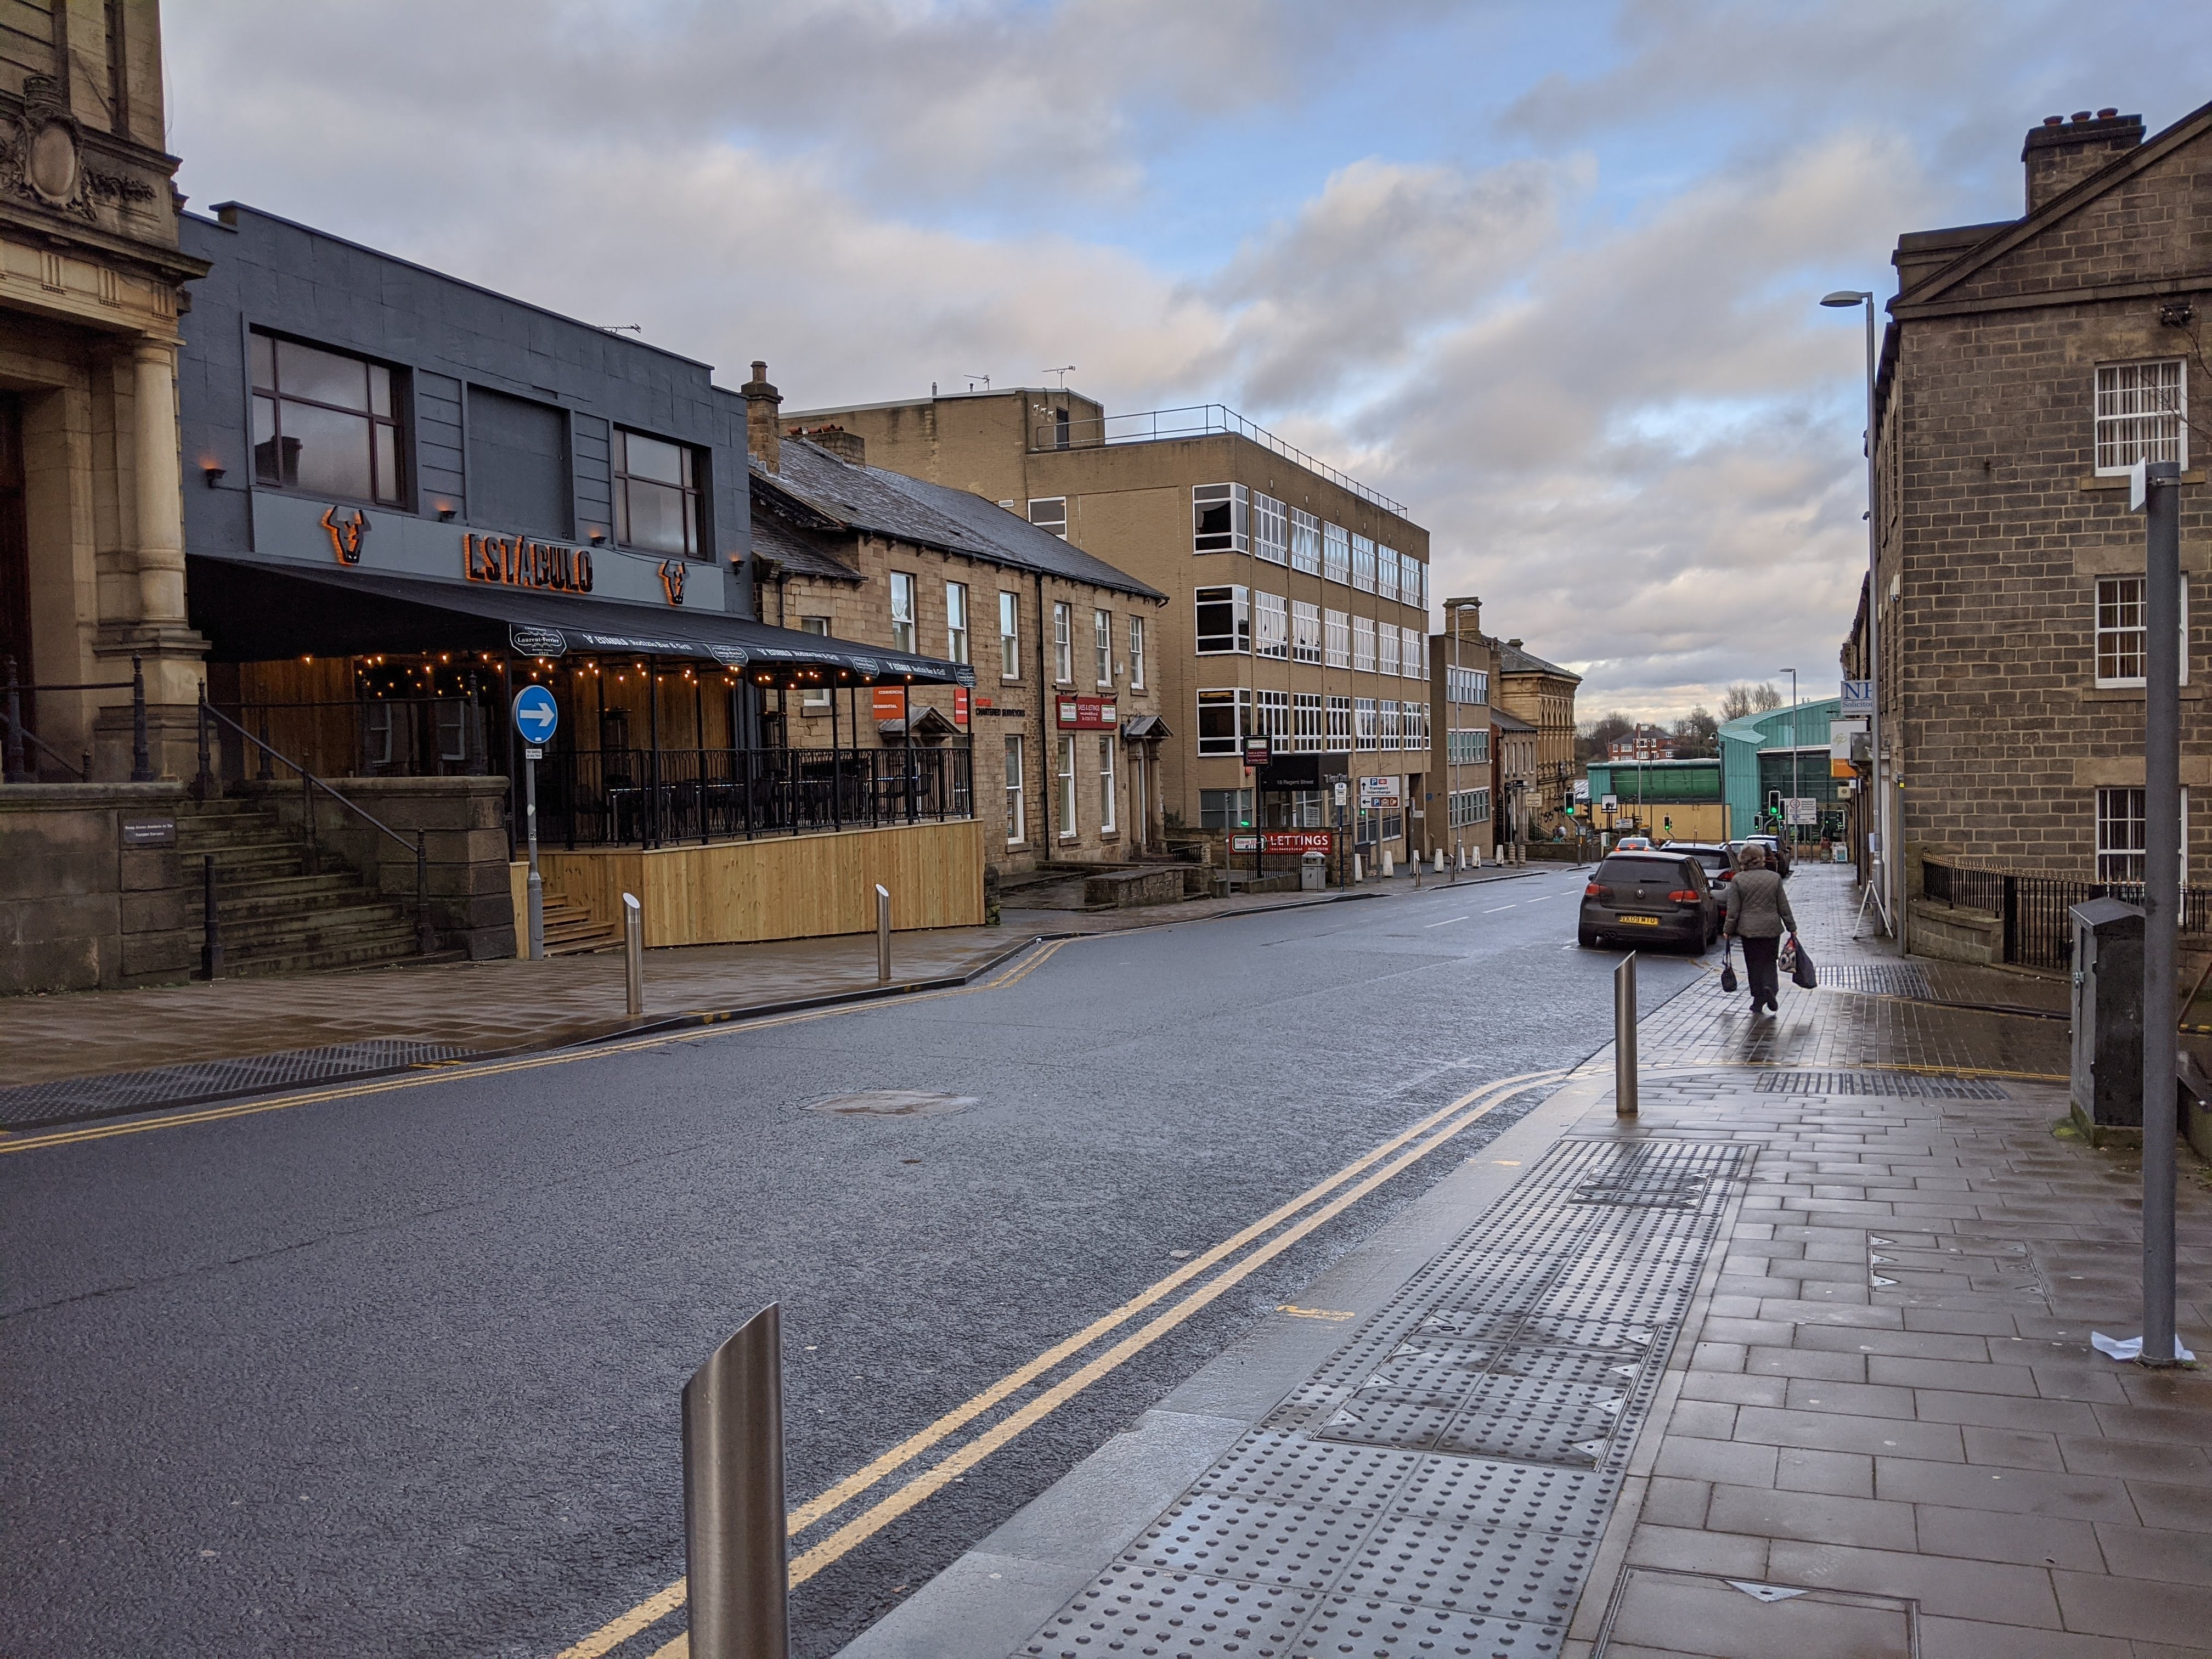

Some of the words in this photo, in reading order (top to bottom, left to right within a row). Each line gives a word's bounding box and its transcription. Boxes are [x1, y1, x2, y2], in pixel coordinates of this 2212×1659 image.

[464, 534, 593, 592] ESTÁBULO
[976, 708, 1001, 716] CHARTERED
[1270, 836, 1328, 845] LETTINGS
